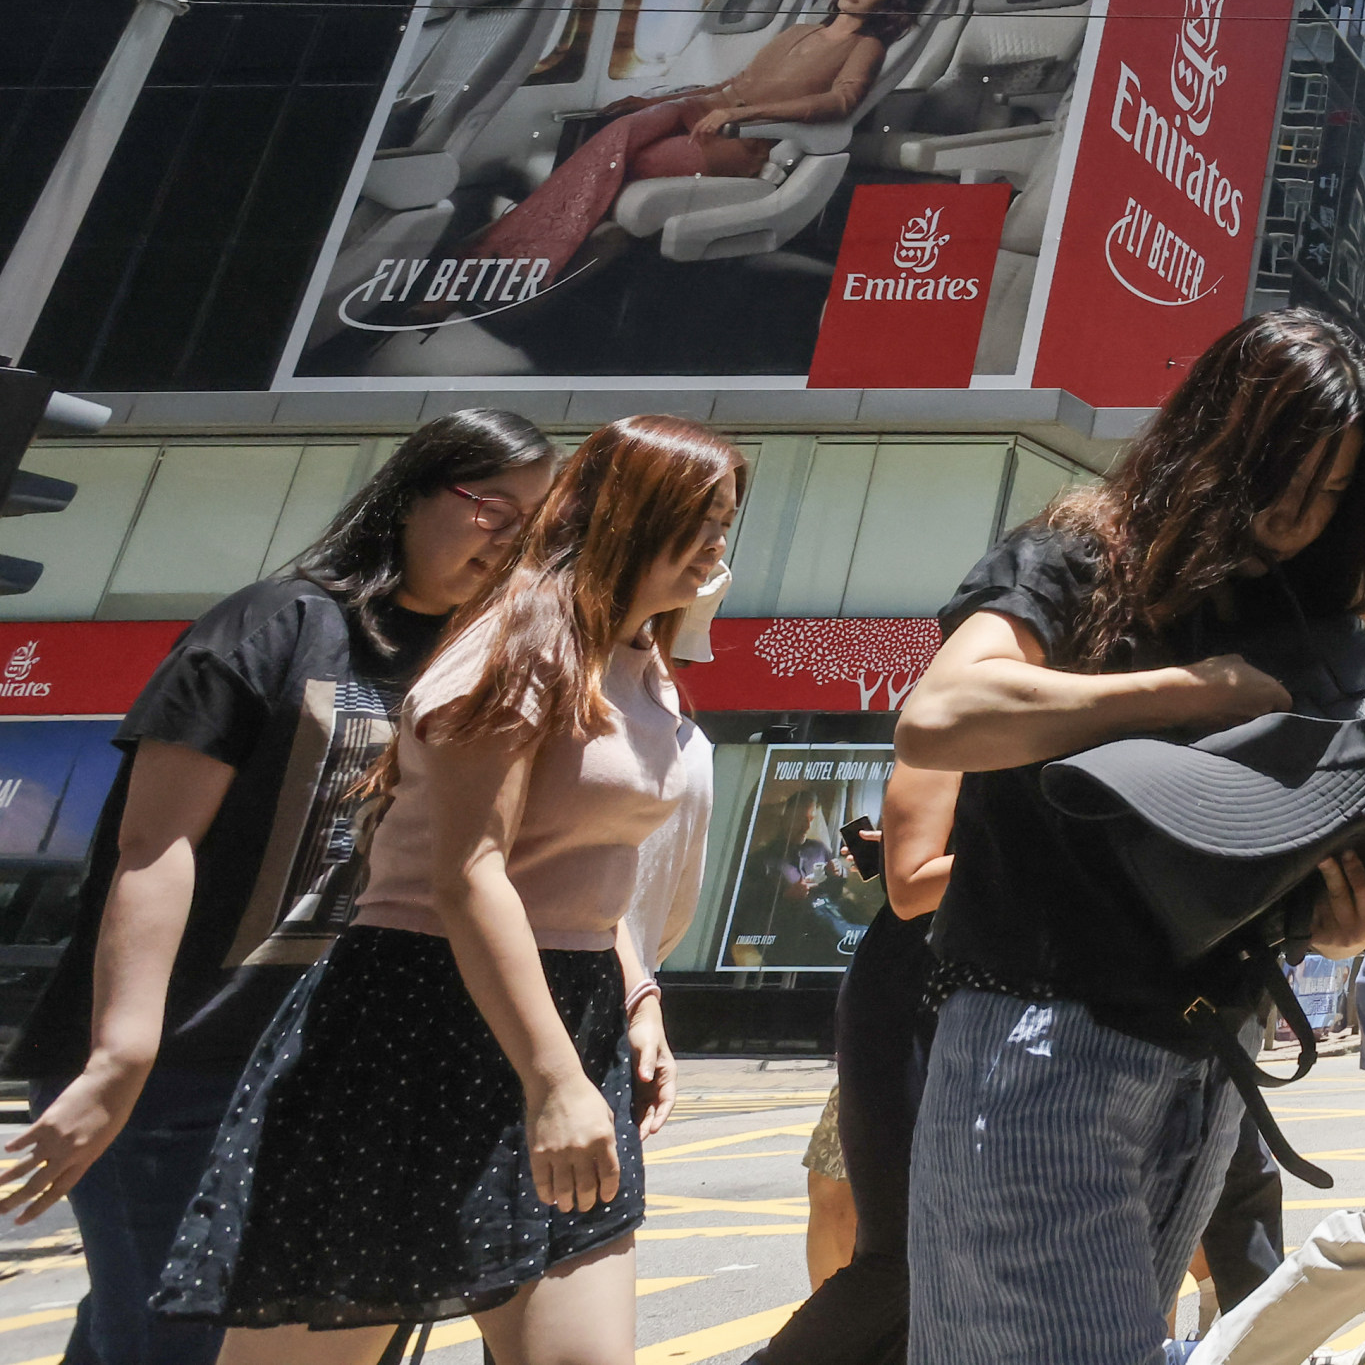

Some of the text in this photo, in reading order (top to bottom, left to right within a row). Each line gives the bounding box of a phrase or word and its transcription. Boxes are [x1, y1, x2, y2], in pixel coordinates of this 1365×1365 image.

[1111, 61, 1243, 237] Emirates
[1116, 197, 1205, 301] FLY BETTER
[362, 258, 551, 302] FLY BETTER
[843, 272, 979, 301] Emirates
[774, 761, 803, 780] YOUR
[803, 761, 834, 780] HOTEL
[834, 761, 869, 780] ROOM
[867, 761, 883, 780] IN
